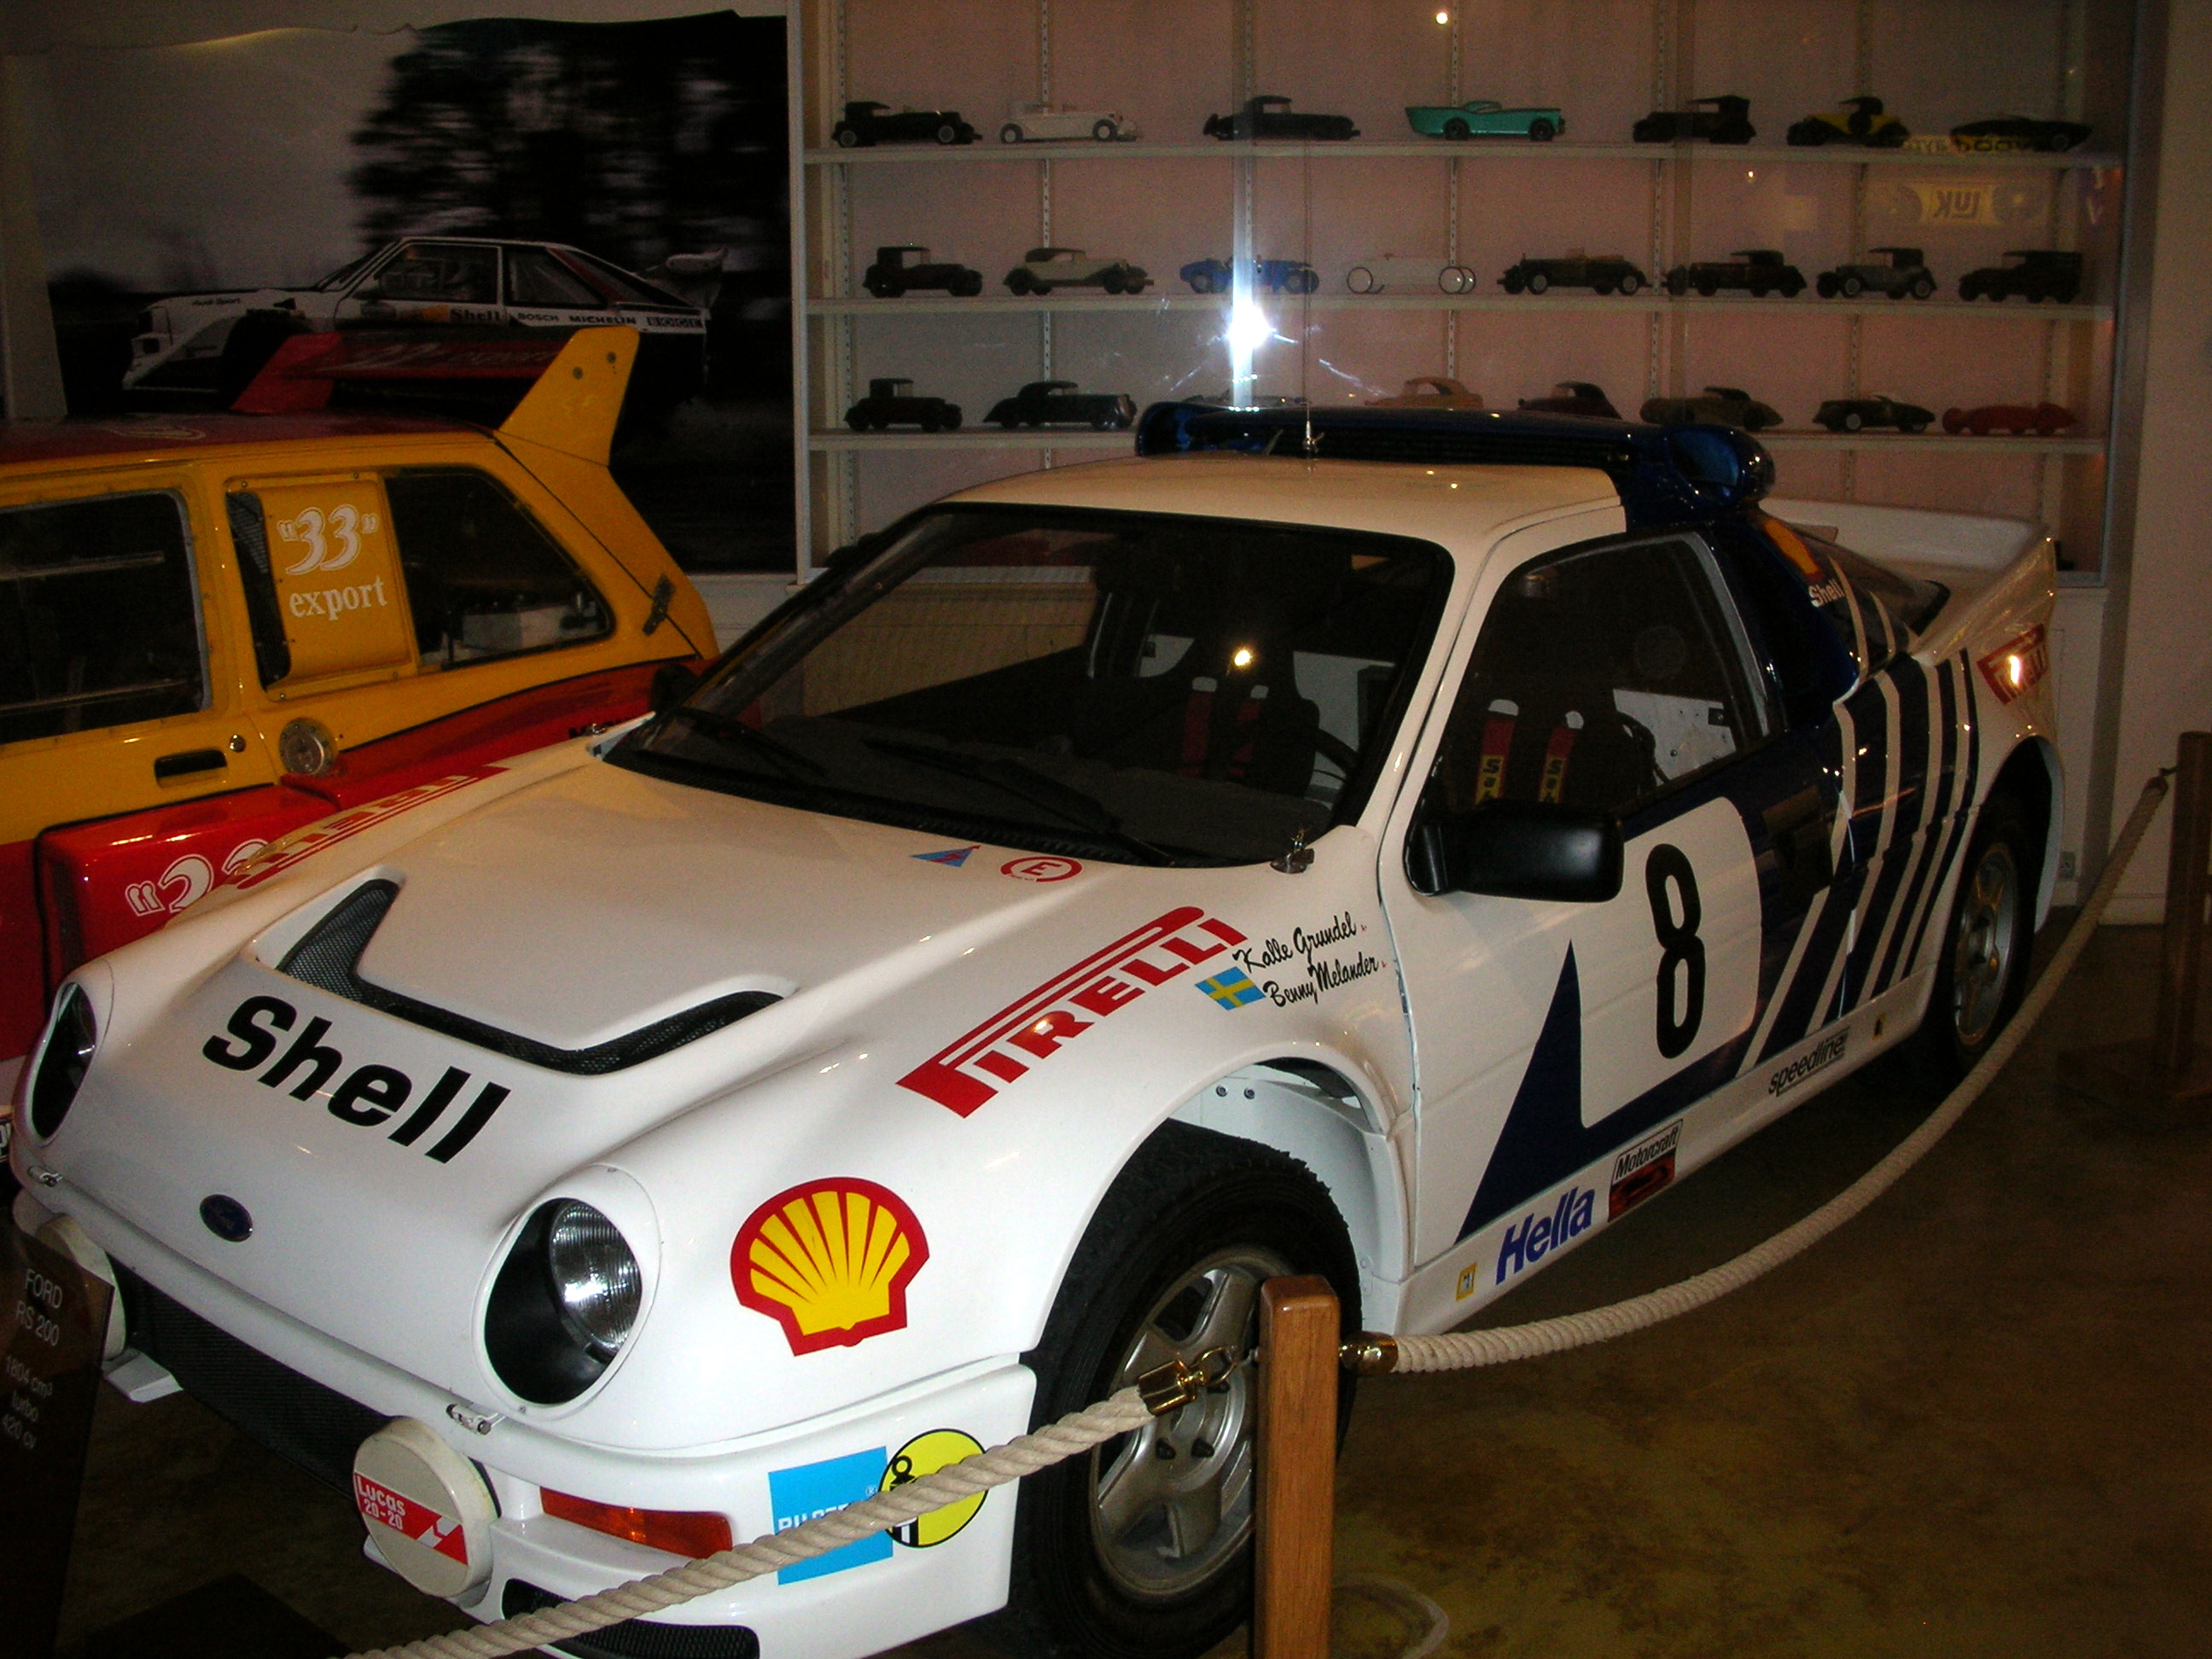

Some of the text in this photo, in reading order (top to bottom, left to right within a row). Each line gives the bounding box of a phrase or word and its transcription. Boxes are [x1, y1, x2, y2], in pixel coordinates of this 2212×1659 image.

[450, 308, 500, 322] Shell
[516, 312, 557, 321] BOSCH
[569, 315, 636, 324] MICHELIN
[288, 576, 387, 621] export
[1807, 579, 1846, 608] Shell
[1232, 911, 1357, 973] Kalle Grundel
[1645, 843, 1705, 1060] 8
[1262, 951, 1379, 1008] Benny Melander
[897, 905, 1248, 1118] PIRELLI
[201, 995, 512, 1164] Shell
[1768, 1033, 1845, 1097] speedline
[1615, 1126, 1679, 1180] Motorcraft
[1496, 1186, 1596, 1285] Hella
[25, 1268, 63, 1309] FORD
[15, 1300, 61, 1347] RS 200
[357, 1476, 406, 1516] Lucas
[363, 1499, 404, 1530] 20-20
